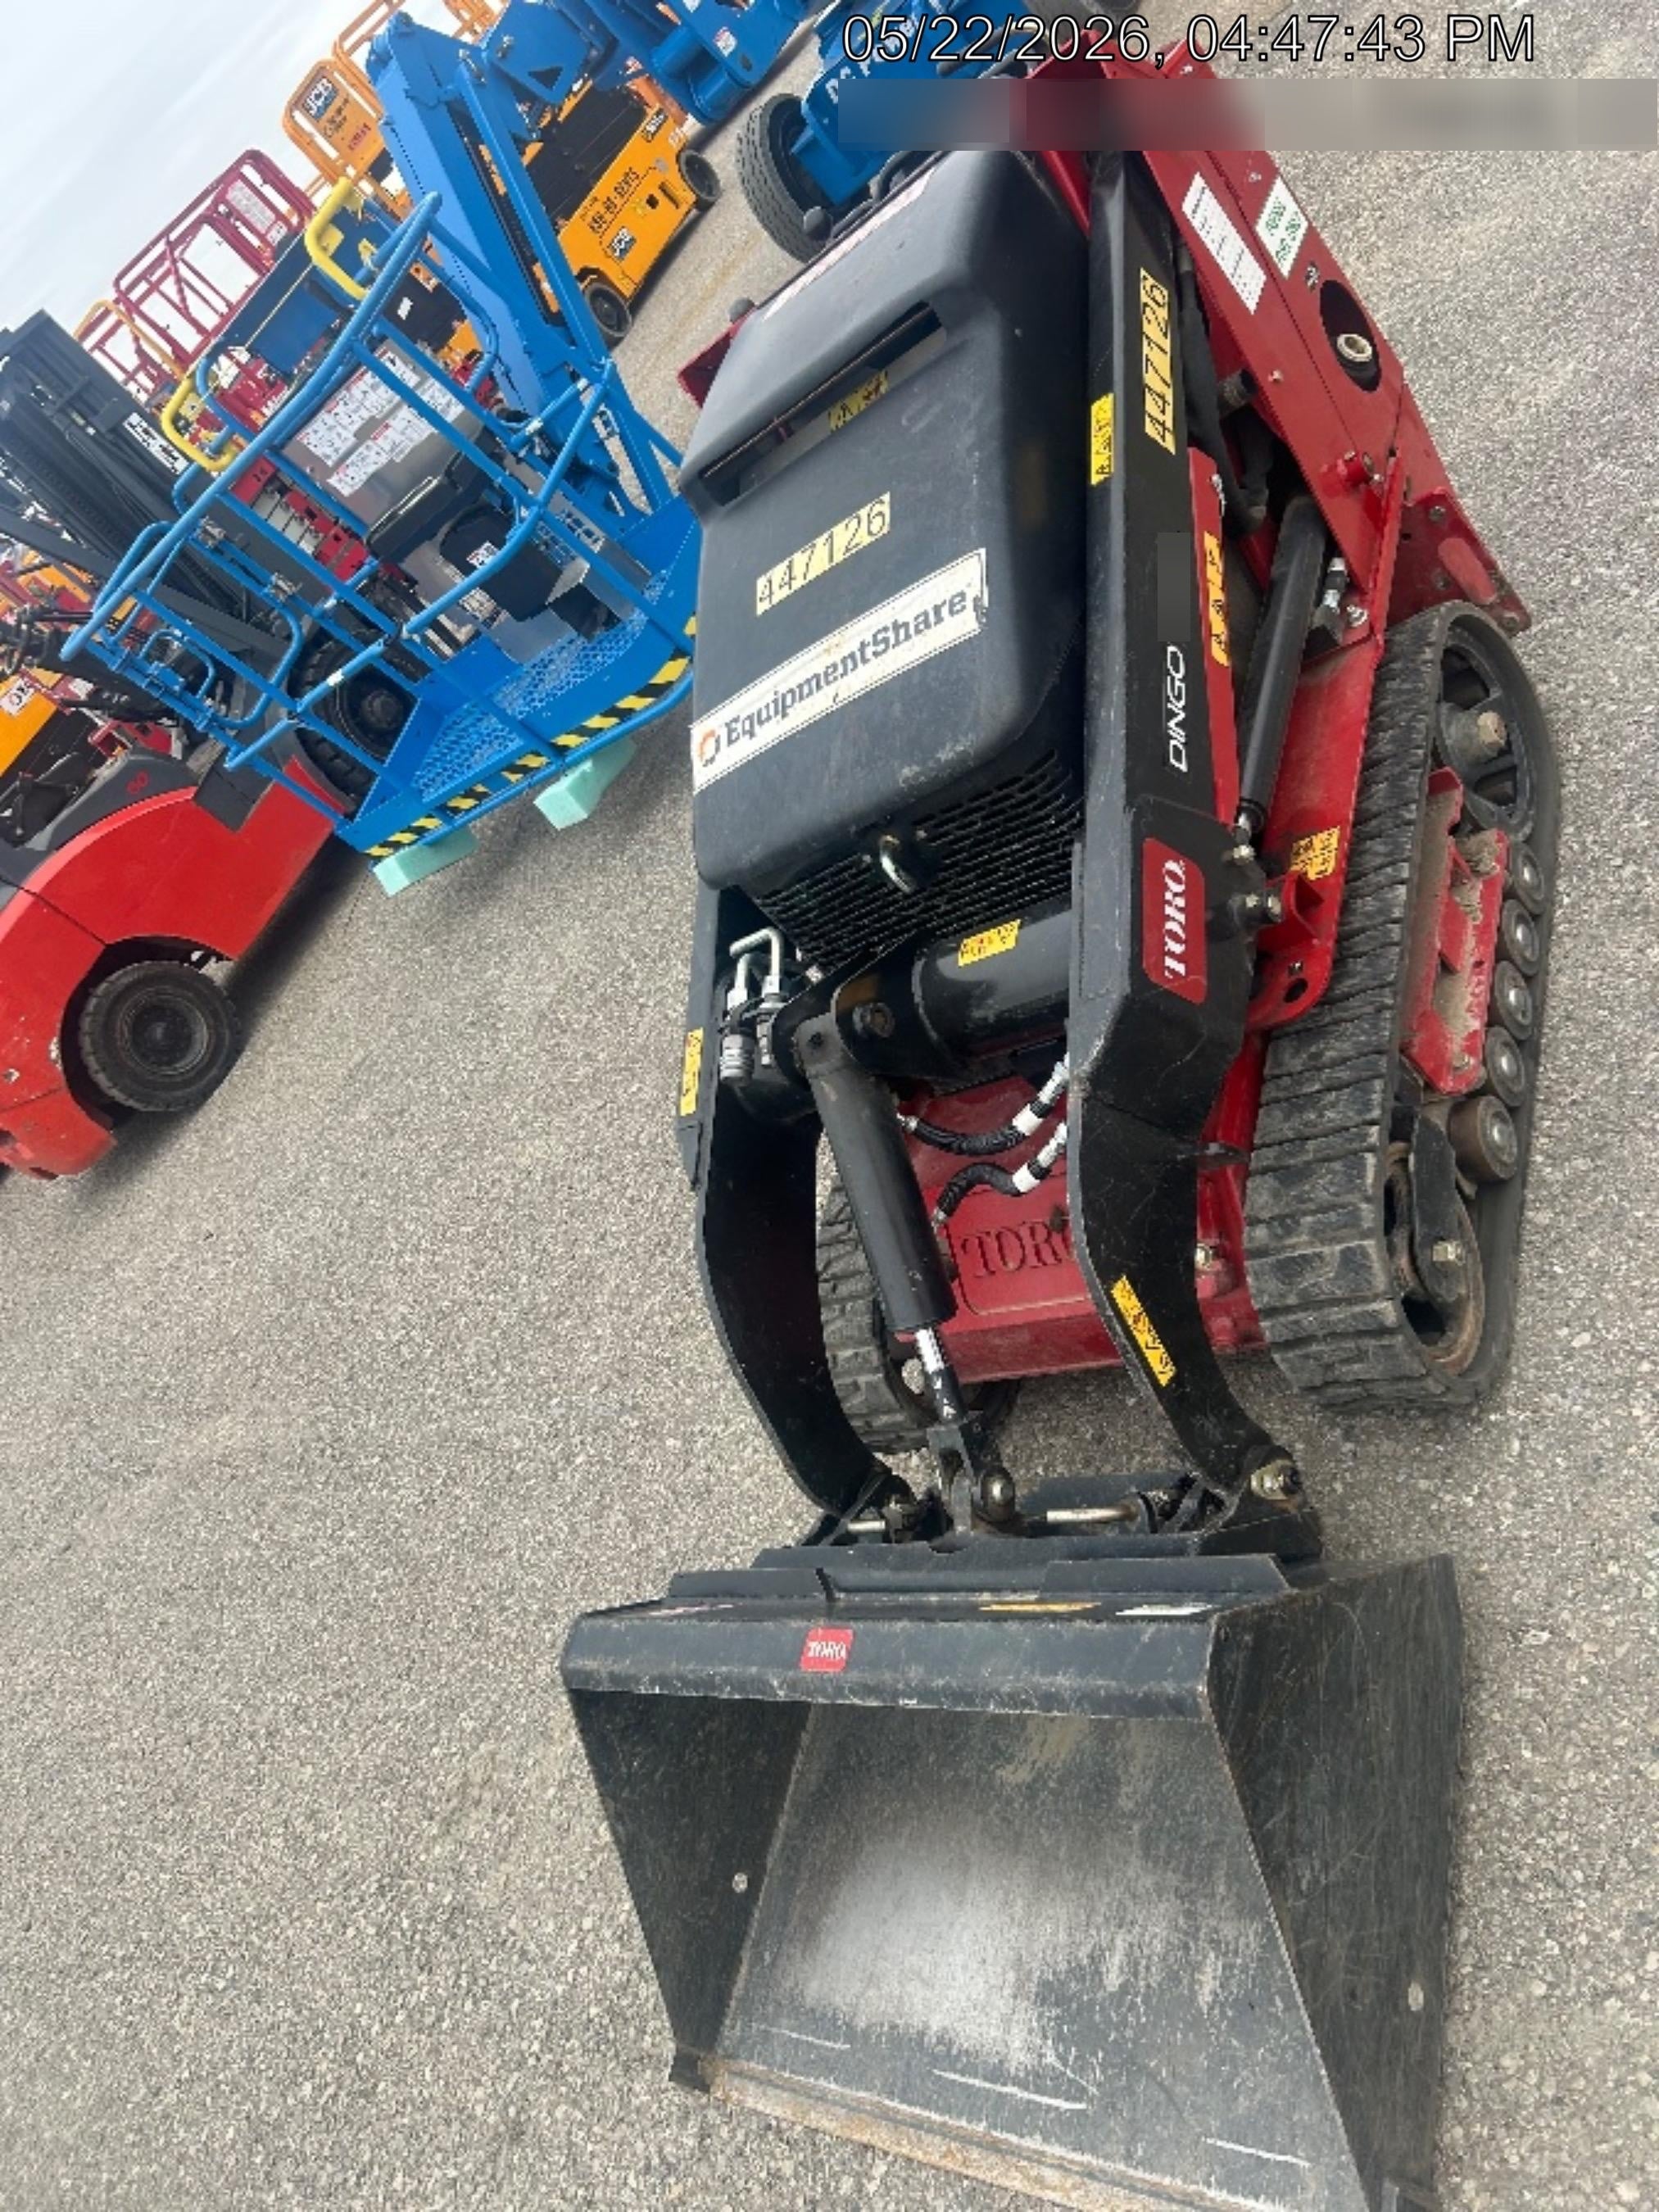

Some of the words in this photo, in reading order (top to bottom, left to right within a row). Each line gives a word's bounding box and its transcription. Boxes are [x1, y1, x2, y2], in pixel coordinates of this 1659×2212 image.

[1143, 274, 1172, 443] 447126
[759, 498, 886, 605] 447126
[724, 588, 968, 747] EquipmentShare
[1167, 645, 1188, 773] DINGO
[1163, 860, 1186, 979] TORO
[961, 1220, 1071, 1278] TOR
[808, 1641, 847, 1660] TORO
